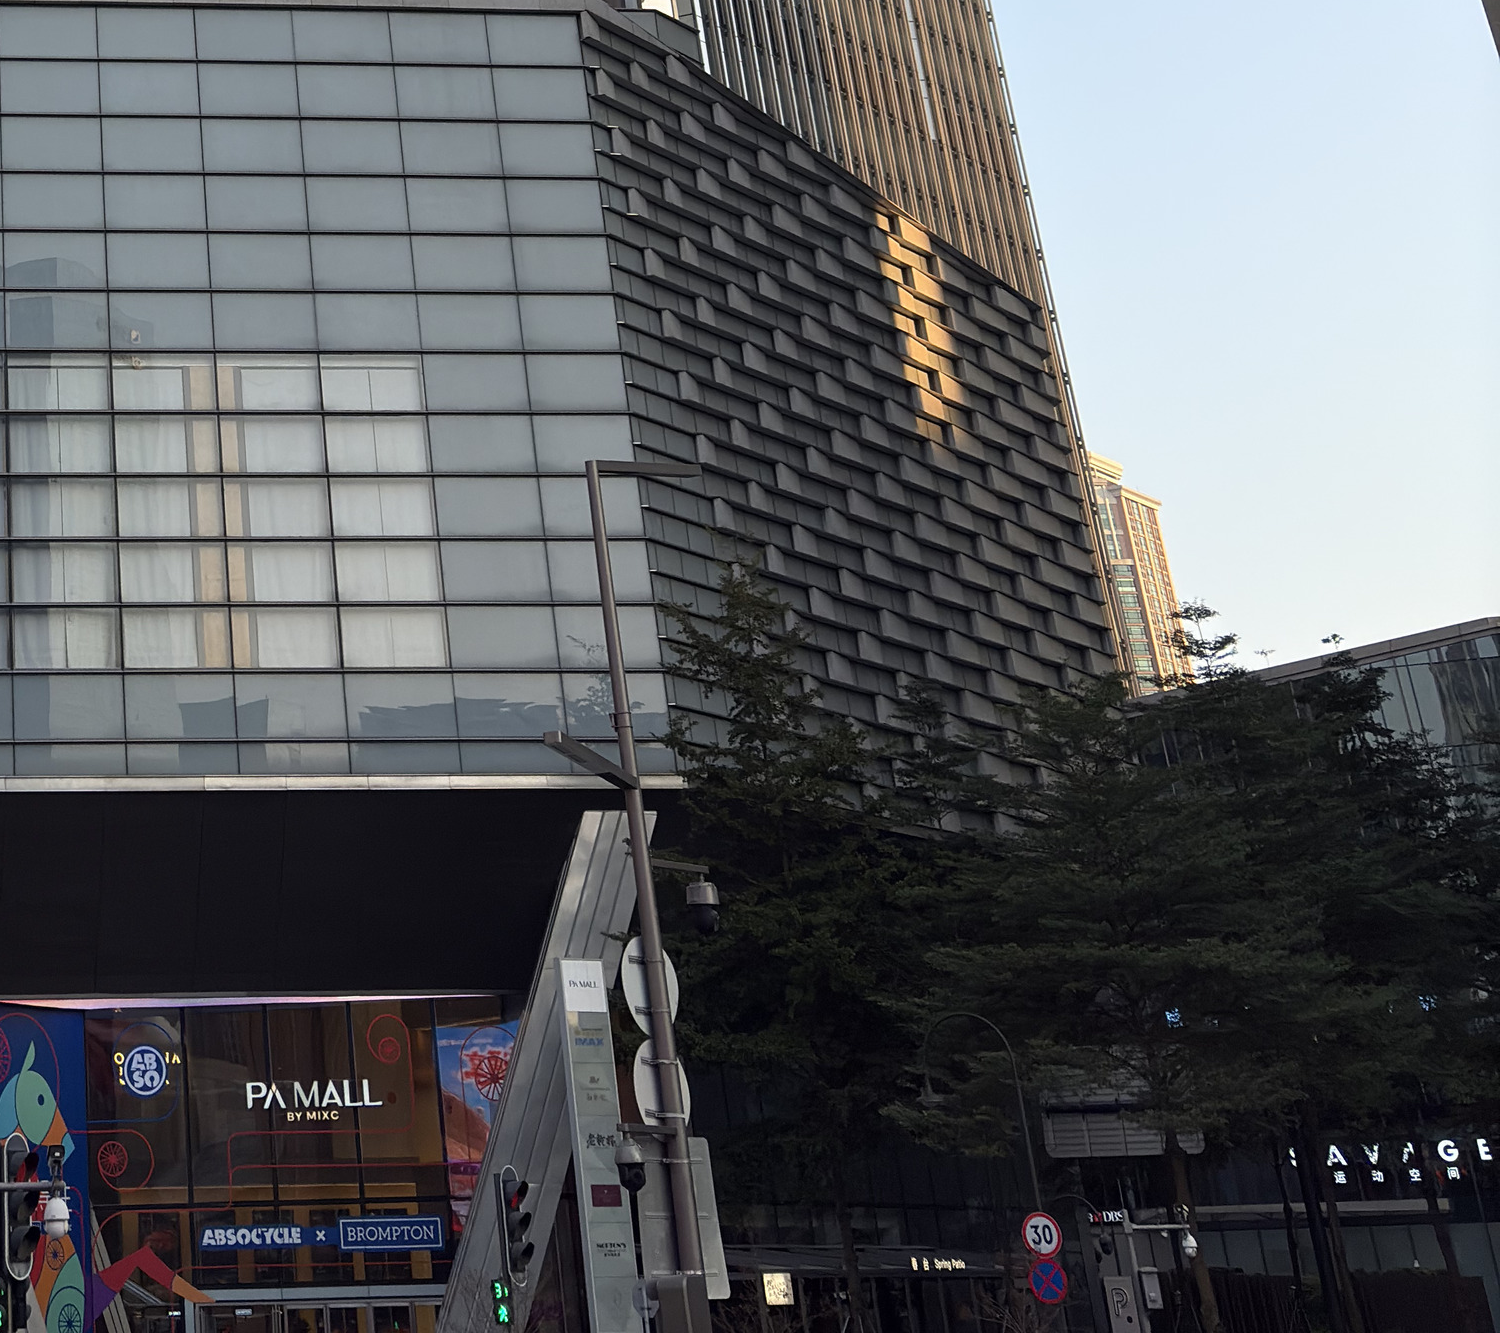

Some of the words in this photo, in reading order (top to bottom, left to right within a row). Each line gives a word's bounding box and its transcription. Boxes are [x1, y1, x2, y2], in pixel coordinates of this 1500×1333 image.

[294, 1079, 384, 1109] MALL
[286, 1112, 303, 1122] BY
[306, 1110, 340, 1121] MIXC
[1102, 1211, 1124, 1223] DBS
[202, 1228, 302, 1246] ABSOCYCLE
[347, 1225, 435, 1242] BROMPTON
[1029, 1224, 1054, 1246] 30
[934, 1258, 952, 1271] Spring
[1111, 1288, 1128, 1317] P
